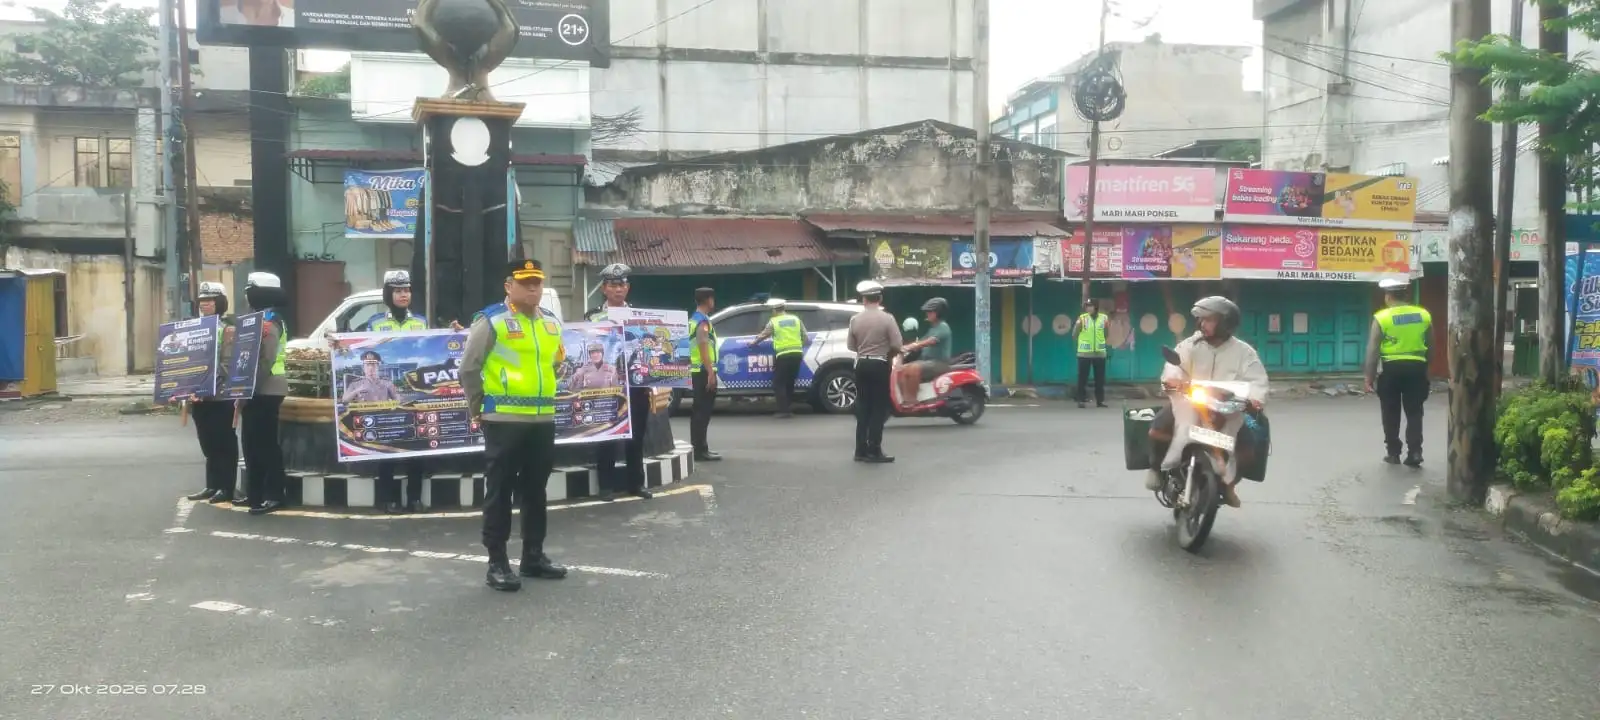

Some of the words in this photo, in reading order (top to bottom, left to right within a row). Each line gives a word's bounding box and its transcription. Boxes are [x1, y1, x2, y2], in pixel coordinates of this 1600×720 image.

[563, 23, 585, 35] 21+
[369, 175, 417, 191] Mika
[1171, 175, 1196, 193] 5G
[1238, 185, 1273, 194] Streaming
[1232, 194, 1253, 203] bebas
[1253, 195, 1278, 204] loading
[1101, 209, 1123, 217] MARI
[1124, 209, 1146, 218] MARI
[1147, 209, 1179, 218] PONSEL
[1225, 233, 1267, 246] Sekarang
[1320, 235, 1377, 247] BUKTIKAN
[1321, 246, 1375, 257] BEDANYA
[1277, 270, 1299, 278] MARI
[1300, 270, 1323, 279] MARI
[1324, 271, 1357, 280] PONSEL
[424, 368, 460, 385] PAT
